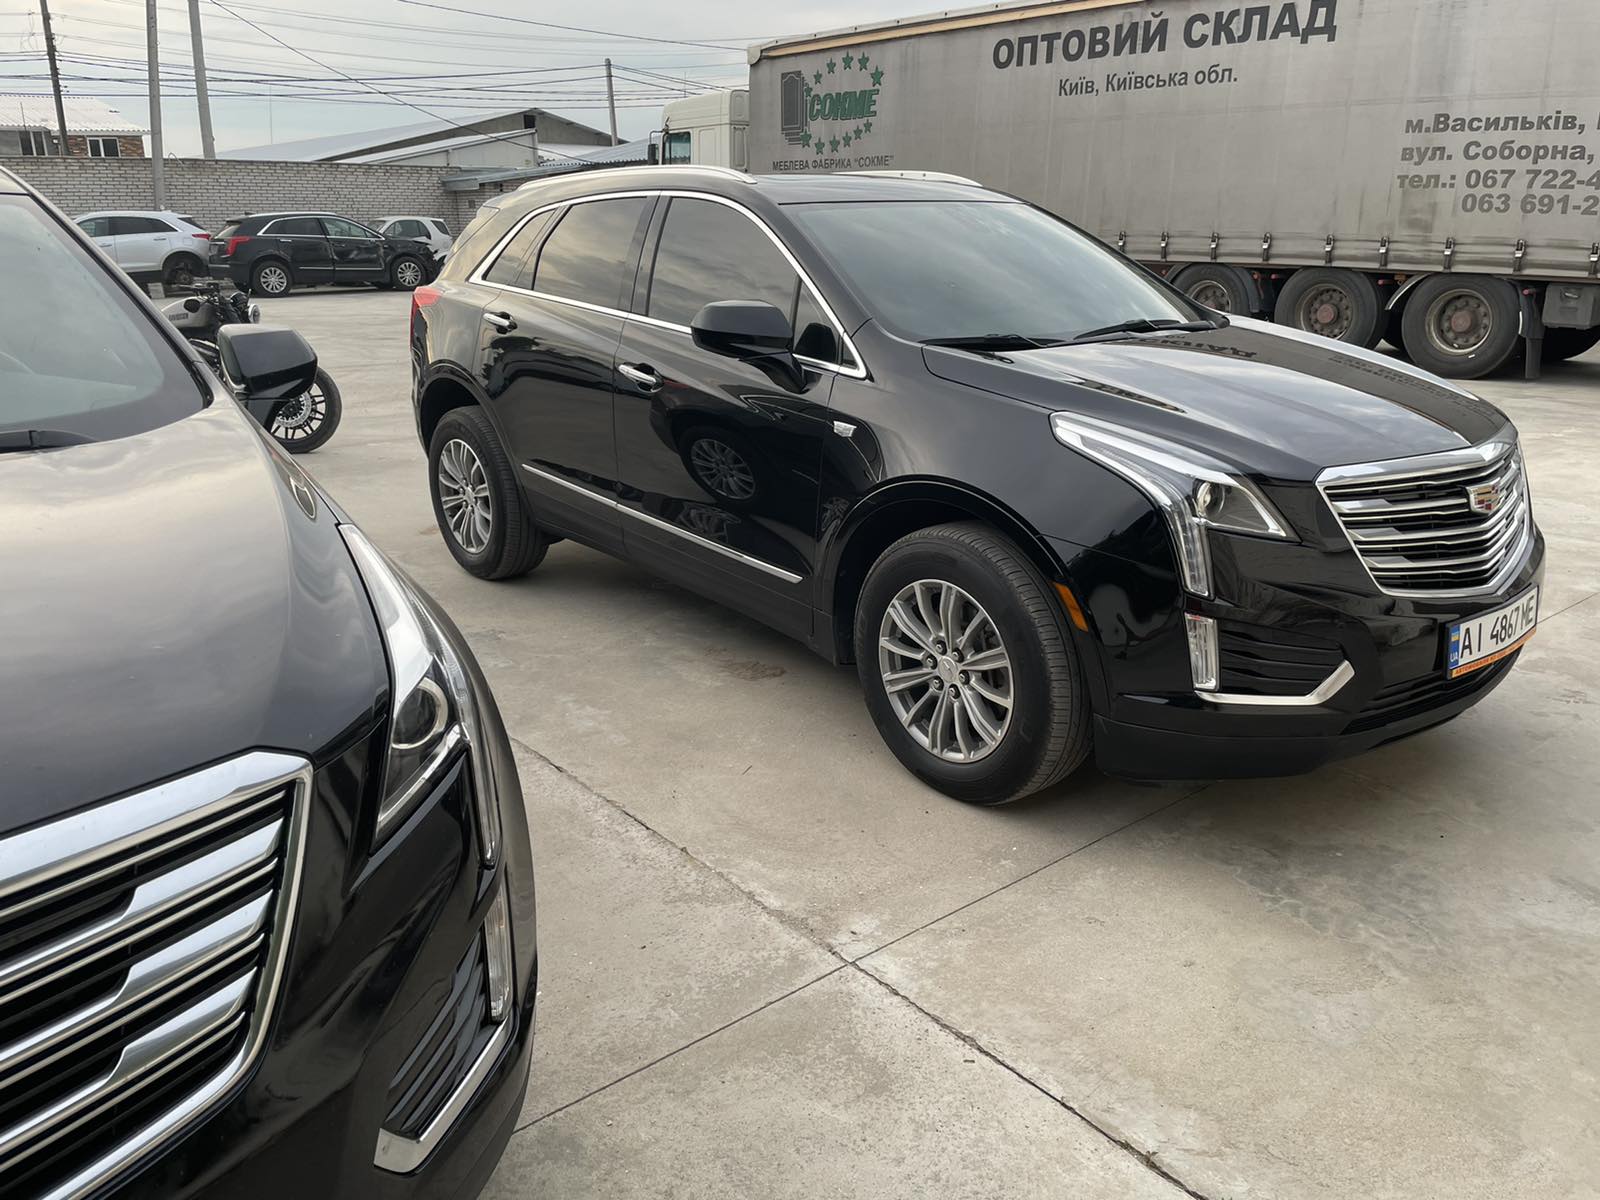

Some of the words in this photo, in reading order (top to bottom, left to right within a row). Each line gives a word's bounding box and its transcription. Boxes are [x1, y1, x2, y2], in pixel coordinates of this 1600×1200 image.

[993, 11, 1169, 69] ОПТОВИЙ
[1183, 0, 1337, 49] СКЛАД
[1059, 76, 1099, 97] Київ,
[1105, 71, 1188, 92] Київська
[1194, 63, 1238, 85] обл.
[1404, 110, 1586, 135] м.Васильків,
[772, 159, 810, 171] МЕБЛЕВА
[811, 158, 852, 169] ФАБРИКА
[1400, 146, 1453, 166] вул.
[1463, 139, 1594, 165] Соборна,
[1397, 174, 1457, 189] тел.:
[1465, 169, 1516, 189] 067
[1526, 169, 1600, 190] 722-4
[1461, 193, 1511, 214] 063
[1520, 194, 1600, 216] 691-2
